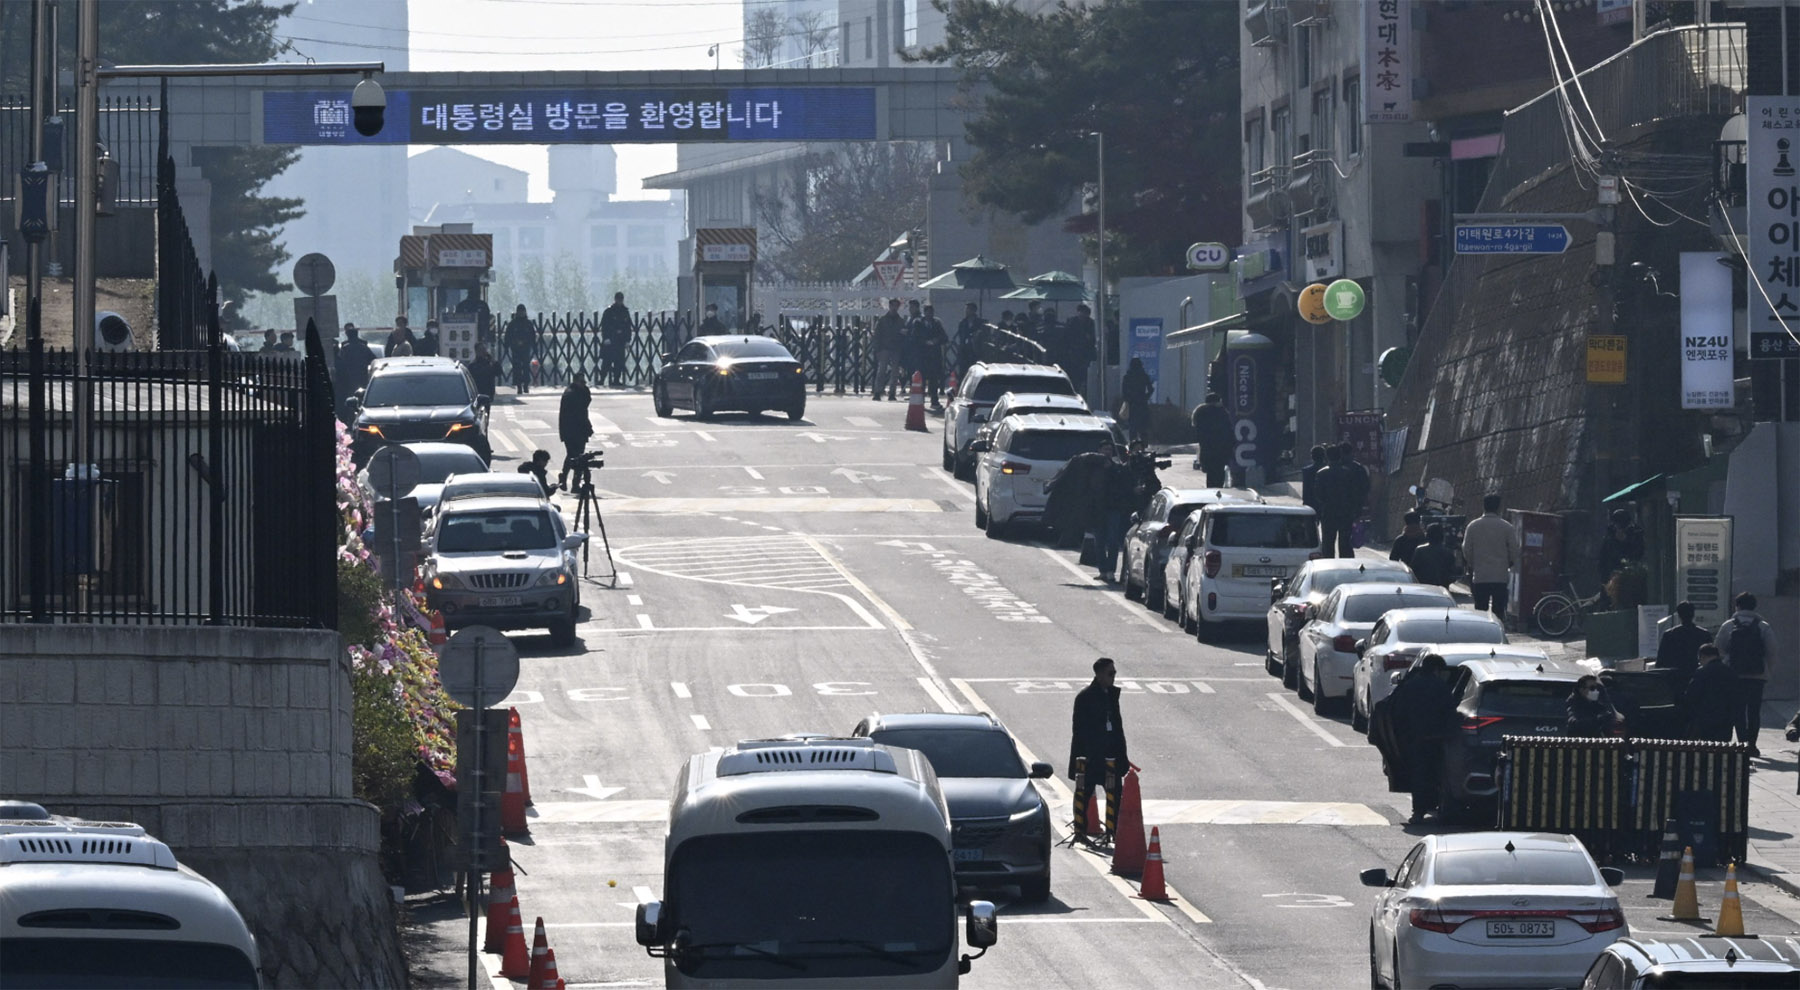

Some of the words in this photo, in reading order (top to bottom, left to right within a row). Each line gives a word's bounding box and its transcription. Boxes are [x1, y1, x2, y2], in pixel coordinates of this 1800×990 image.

[422, 103, 534, 131] 대통령실
[546, 101, 630, 130] 방문을
[640, 101, 782, 129] 환영합니다
[1459, 228, 1535, 240] 이태원로4가길
[1458, 243, 1503, 251] Itaewon-ro
[1504, 243, 1533, 252] 4ga-gil
[1196, 250, 1221, 262] CU
[1685, 336, 1728, 348] NZ4U
[1686, 350, 1728, 361] 엔젯포유
[1239, 365, 1249, 392] Nice
[1239, 394, 1248, 407] to
[1339, 416, 1379, 424] LUNCH
[1234, 419, 1258, 468] CU
[1493, 923, 1515, 934] 50노
[1520, 923, 1548, 934] 0873
